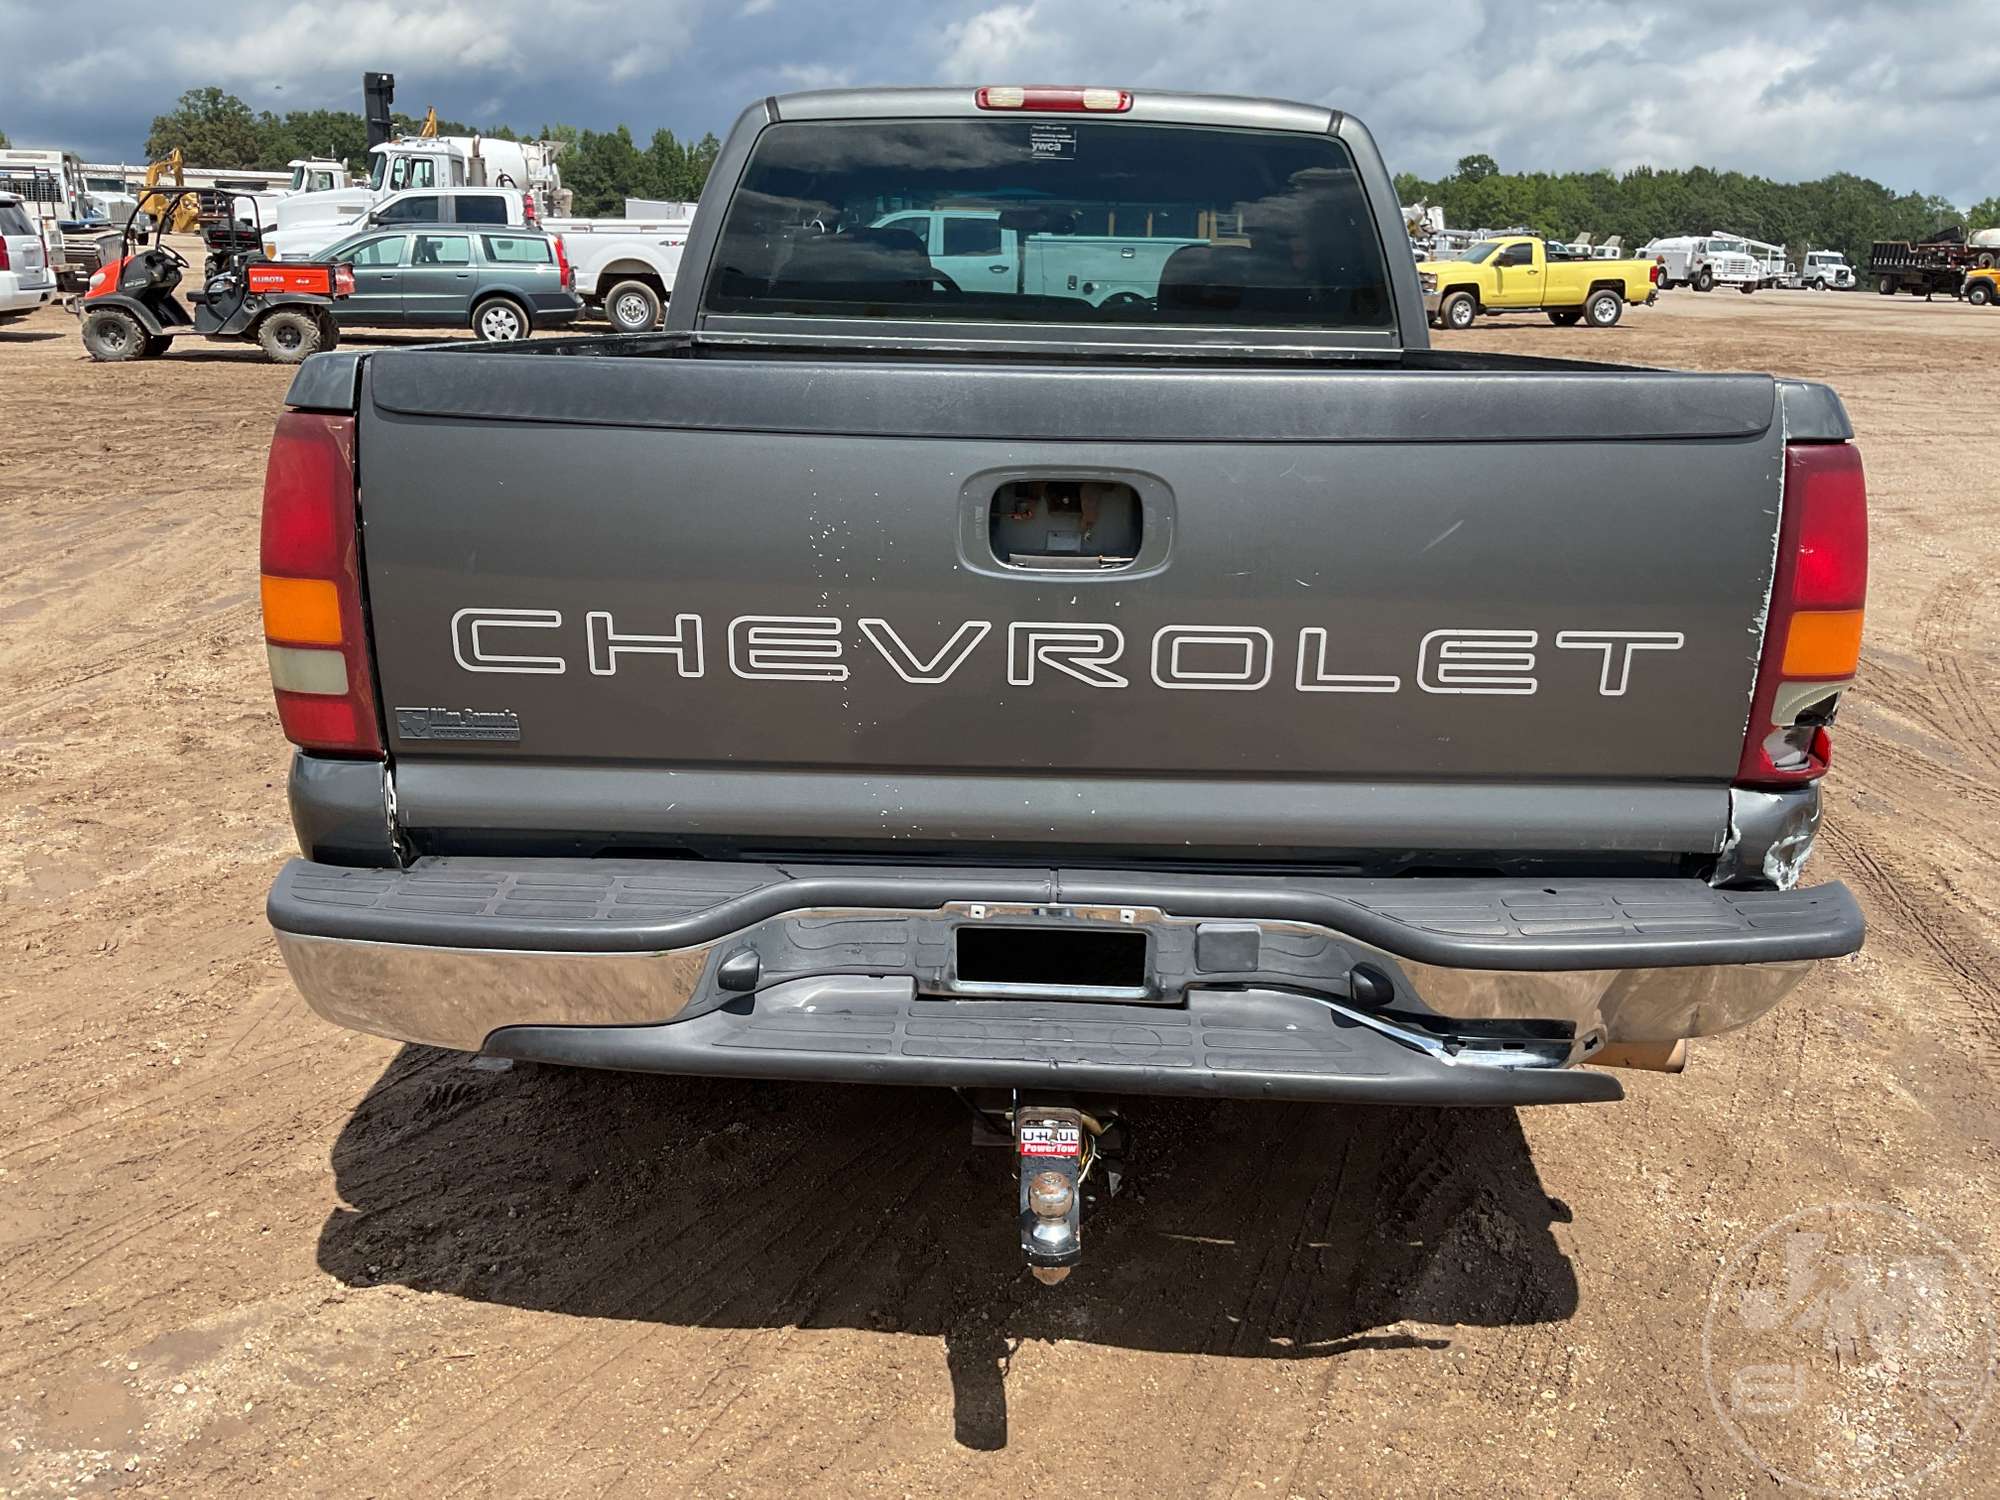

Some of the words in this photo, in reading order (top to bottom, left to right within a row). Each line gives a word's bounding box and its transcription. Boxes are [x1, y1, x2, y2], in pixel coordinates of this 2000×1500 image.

[1032, 142, 1061, 152] ywca
[252, 276, 285, 284] KUBOTA
[451, 607, 1685, 696] CHEVROLET
[1023, 1143, 1077, 1153] PowerTow
